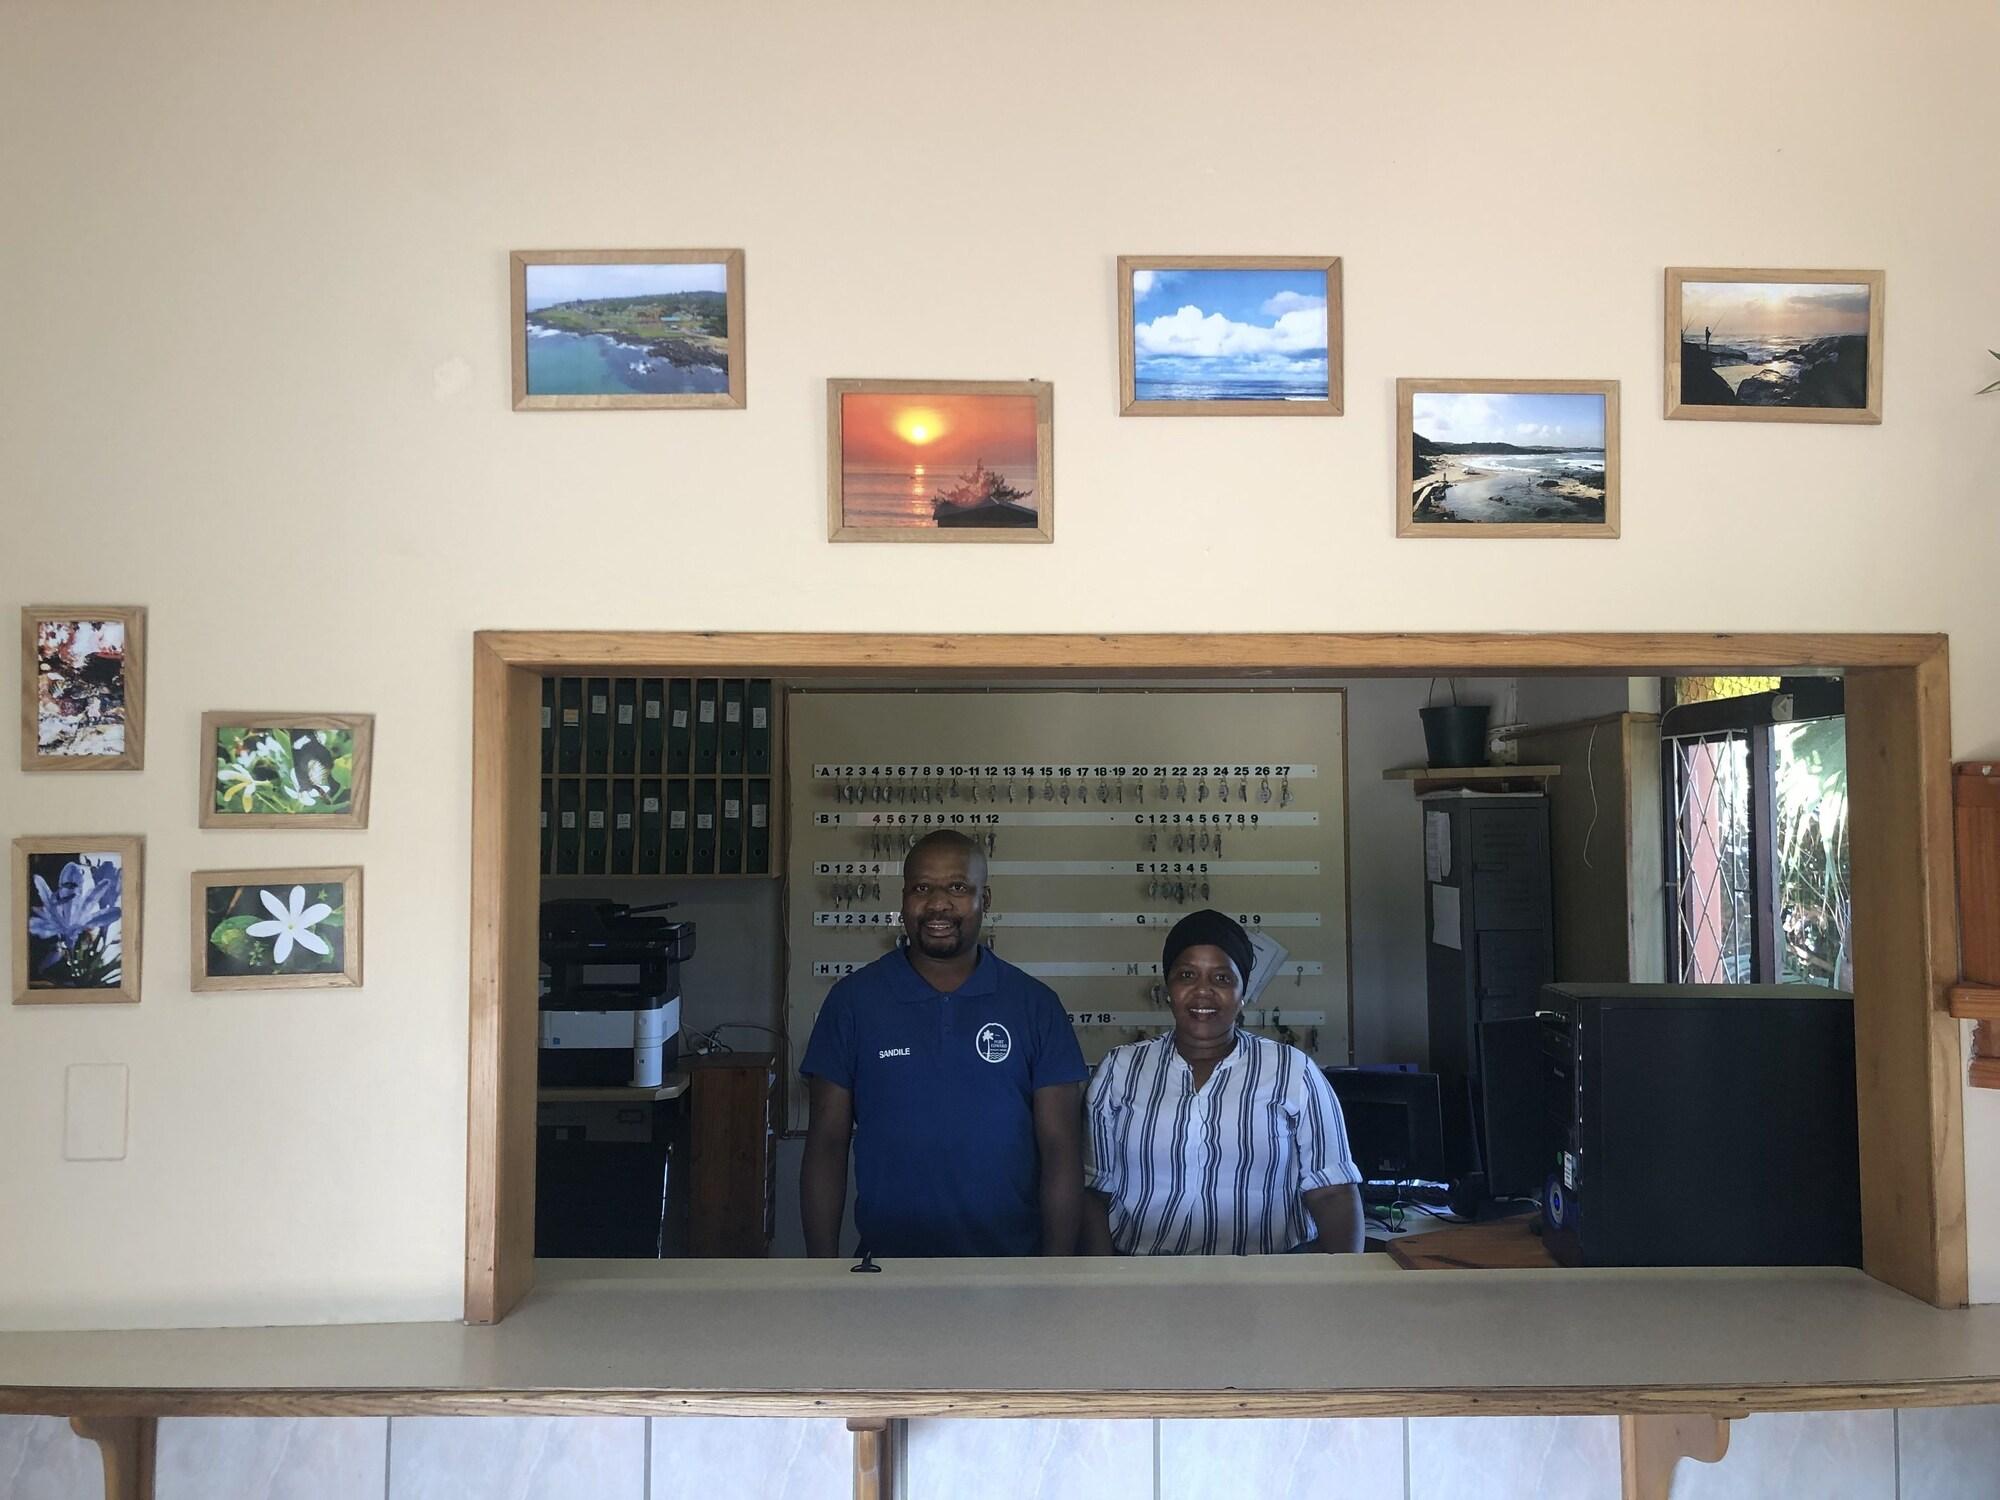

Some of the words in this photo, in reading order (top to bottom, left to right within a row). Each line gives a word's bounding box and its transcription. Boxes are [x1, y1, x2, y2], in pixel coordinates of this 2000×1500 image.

[820, 766, 831, 776] A
[834, 766, 841, 776] 1
[845, 766, 854, 776] 2
[858, 766, 867, 776] 3
[871, 766, 880, 776] 4
[884, 766, 893, 776] 5
[897, 766, 906, 776] 6
[910, 766, 919, 776] 7
[922, 766, 932, 776] 8
[935, 766, 945, 776] 9
[948, 766, 964, 776] 10
[967, 766, 980, 776] 11
[984, 766, 998, 776] 12
[1002, 766, 1017, 776] 13
[1021, 766, 1035, 776] 14
[1039, 766, 1053, 776] 15
[1058, 766, 1072, 776] 16
[1076, 766, 1090, 776] 17
[1093, 766, 1108, 776] 18
[1112, 766, 1126, 776] 19
[1131, 766, 1149, 776] 20
[1153, 766, 1167, 776] 21
[1171, 766, 1188, 776] 22
[1192, 766, 1208, 776] 23
[1213, 766, 1229, 776] 24
[1234, 766, 1250, 776] 25
[1254, 766, 1270, 776] 26
[1275, 766, 1291, 776] 27
[820, 814, 830, 824] B
[833, 814, 841, 824] 1
[872, 814, 881, 824] 4
[886, 814, 895, 824] 5
[898, 814, 907, 824] 6
[910, 814, 919, 824] 7
[923, 814, 932, 824] 8
[936, 814, 945, 824] 9
[949, 814, 965, 824] 10
[969, 814, 981, 824] 11
[985, 814, 1000, 824] 12
[1134, 814, 1144, 824] C
[1148, 814, 1155, 824] 1
[1159, 814, 1168, 824] 2
[1172, 814, 1181, 824] 3
[1185, 814, 1194, 824] 4
[1199, 814, 1207, 824] 5
[1211, 814, 1220, 824] 6
[1224, 814, 1233, 824] 7
[1237, 814, 1246, 824] 8
[1250, 814, 1259, 824] 9
[820, 864, 830, 874] D
[834, 864, 841, 874] 1
[845, 864, 854, 874] 2
[858, 864, 867, 874] 3
[871, 864, 881, 874] 4
[1135, 863, 1145, 873] E
[1149, 863, 1156, 873] 1
[1160, 863, 1169, 873] 2
[1173, 863, 1182, 873] 3
[1186, 863, 1195, 873] 4
[1199, 863, 1208, 873] 5
[820, 914, 830, 924] F
[834, 914, 841, 924] 1
[844, 914, 854, 924] 2
[858, 914, 867, 924] 3
[871, 914, 880, 924] 4
[884, 914, 893, 924] 5
[1136, 915, 1146, 925] G
[1239, 915, 1248, 924] 8
[1252, 915, 1261, 924] 9
[820, 964, 830, 974] H
[834, 964, 841, 974] 1
[844, 964, 854, 974] 2
[1151, 964, 1157, 973] 1
[1079, 1013, 1092, 1023] 17
[1096, 1013, 1111, 1023] 18
[879, 1047, 911, 1059] SANDILE
